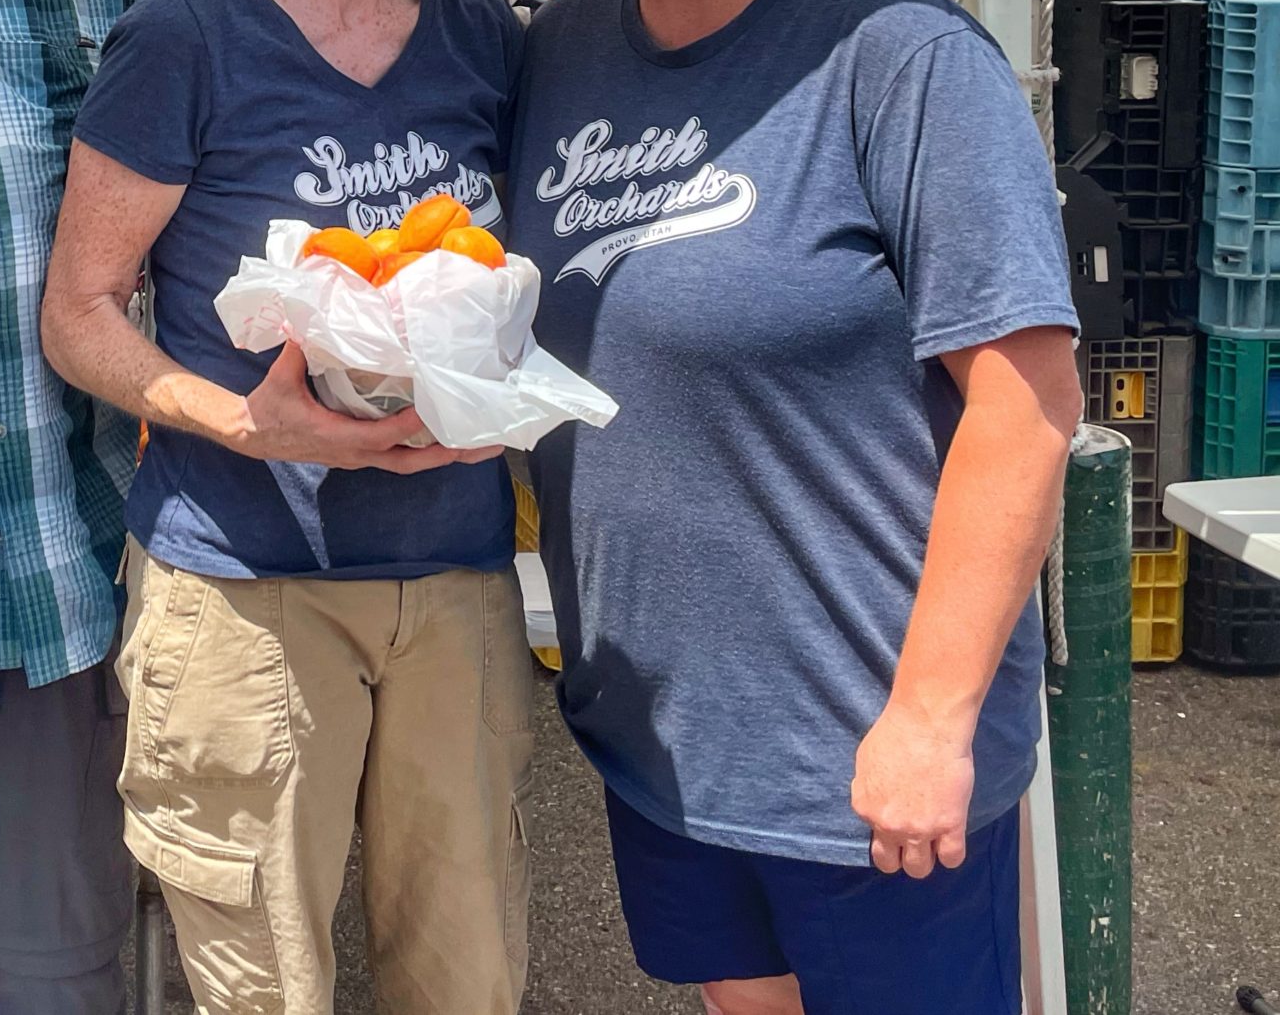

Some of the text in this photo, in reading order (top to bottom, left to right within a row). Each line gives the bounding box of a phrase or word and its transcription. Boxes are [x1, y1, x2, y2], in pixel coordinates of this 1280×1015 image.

[294, 131, 449, 207] Smith
[537, 116, 708, 201] Smith
[553, 162, 728, 236] Orchards
[644, 225, 672, 238] UTAH
